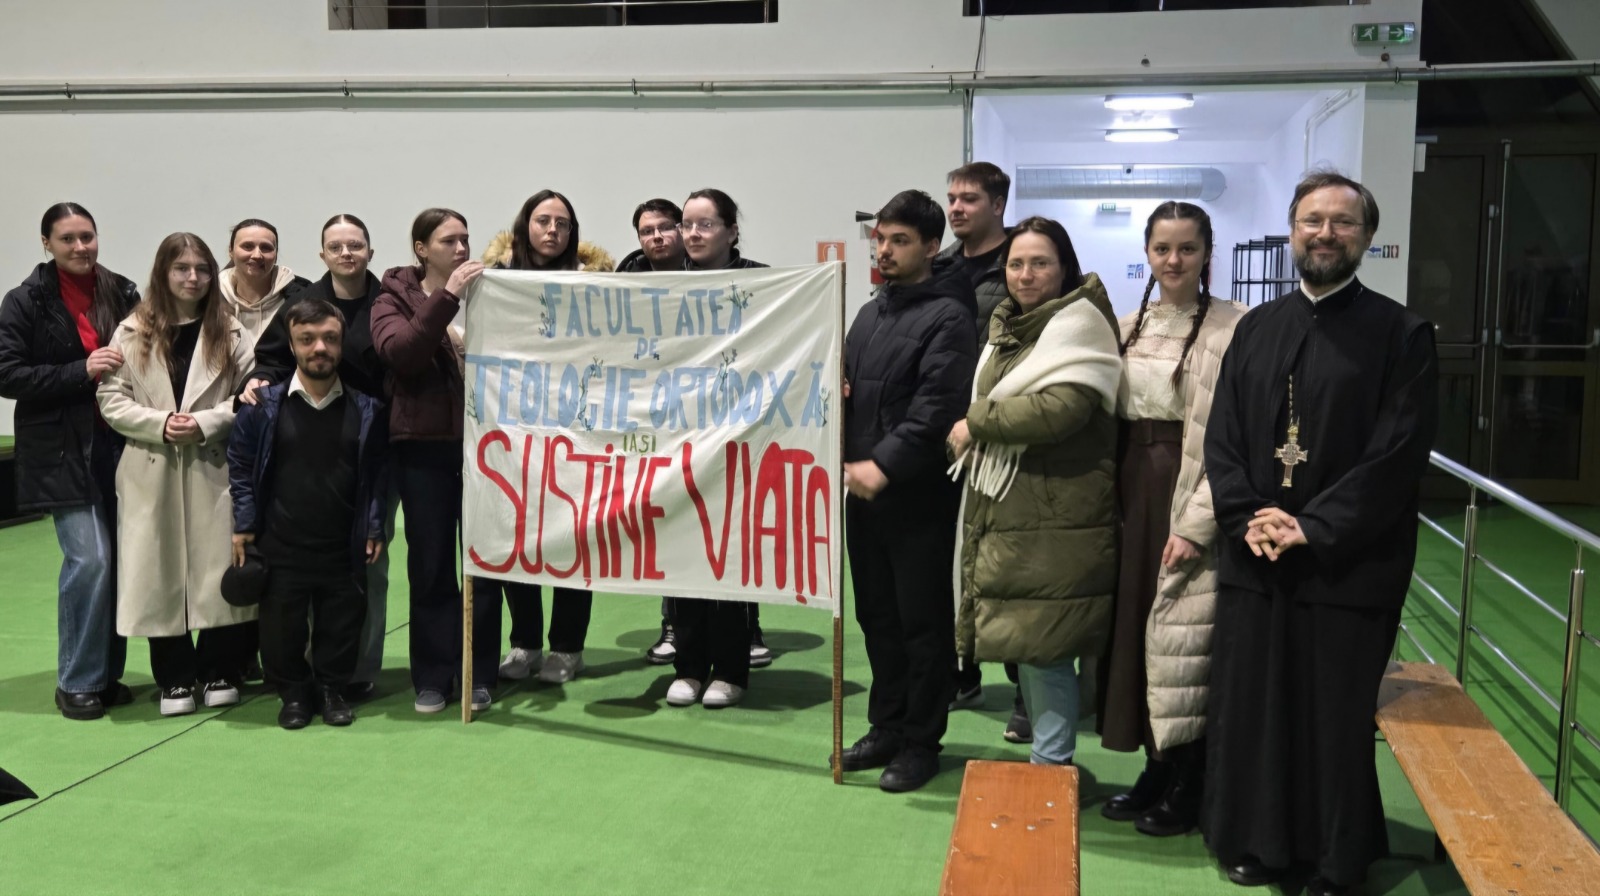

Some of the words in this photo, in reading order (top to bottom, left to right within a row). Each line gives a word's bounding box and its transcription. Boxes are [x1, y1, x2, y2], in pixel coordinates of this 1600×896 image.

[543, 283, 742, 337] FACULTATEA
[636, 338, 659, 357] DE
[465, 354, 646, 431] TEOLOGIE
[649, 361, 824, 430] ORTODOXĂ
[682, 441, 832, 604] VIAȚA
